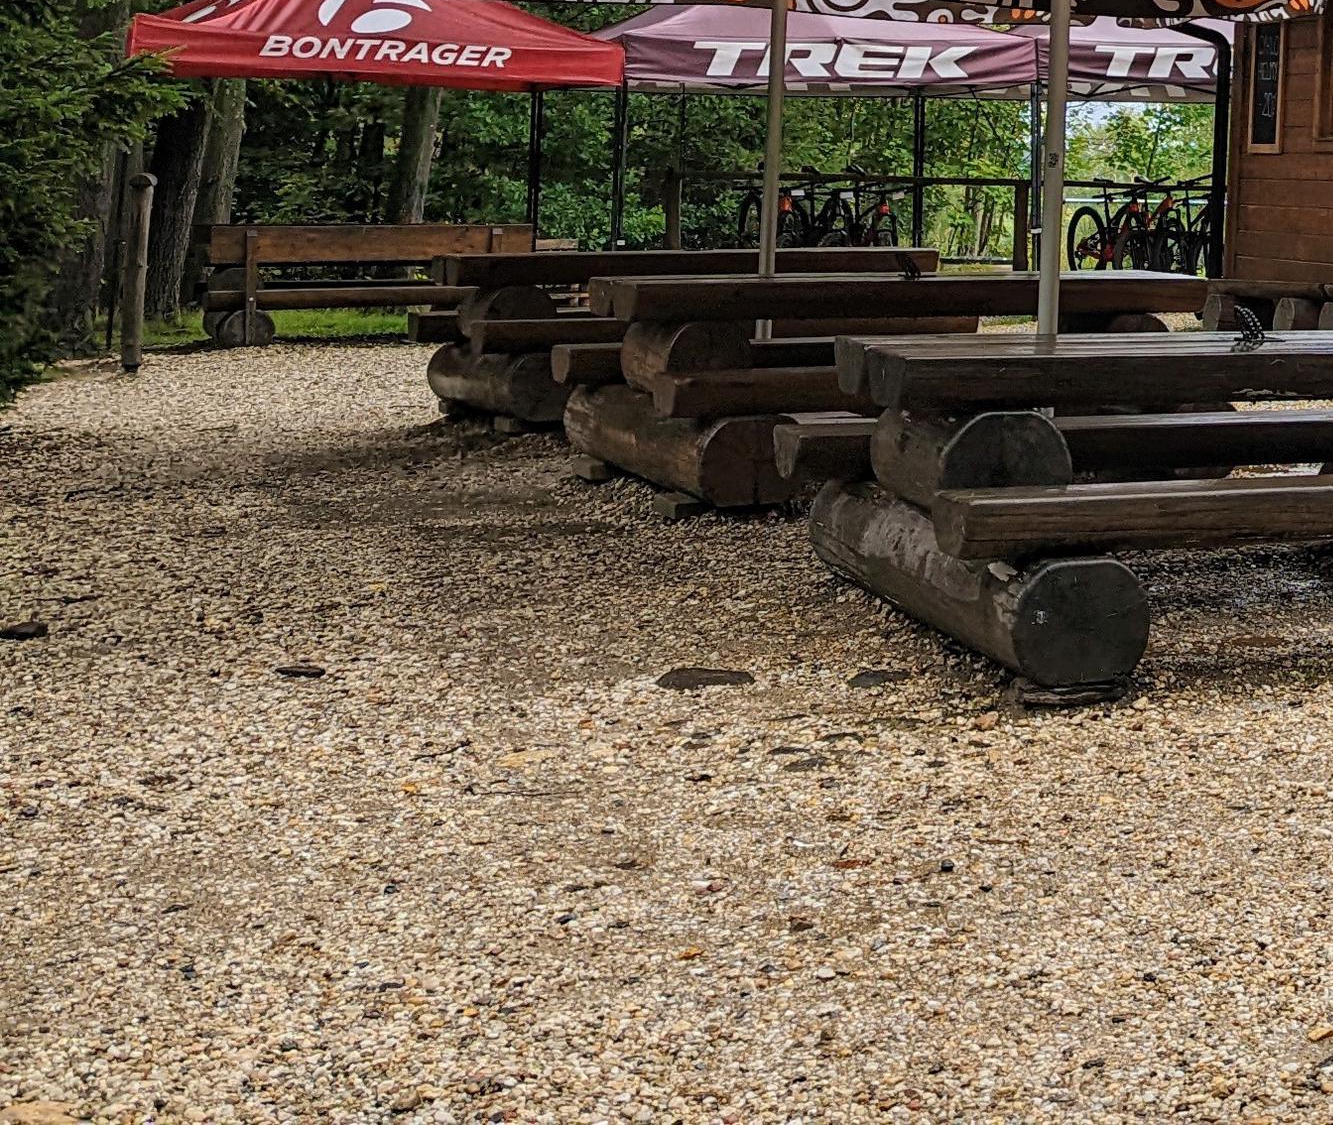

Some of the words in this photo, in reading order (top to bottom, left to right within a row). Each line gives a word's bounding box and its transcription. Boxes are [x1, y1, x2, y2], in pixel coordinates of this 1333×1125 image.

[259, 35, 513, 69] BONTRAGER
[692, 41, 978, 79] TREK
[1095, 45, 1219, 79] TR
